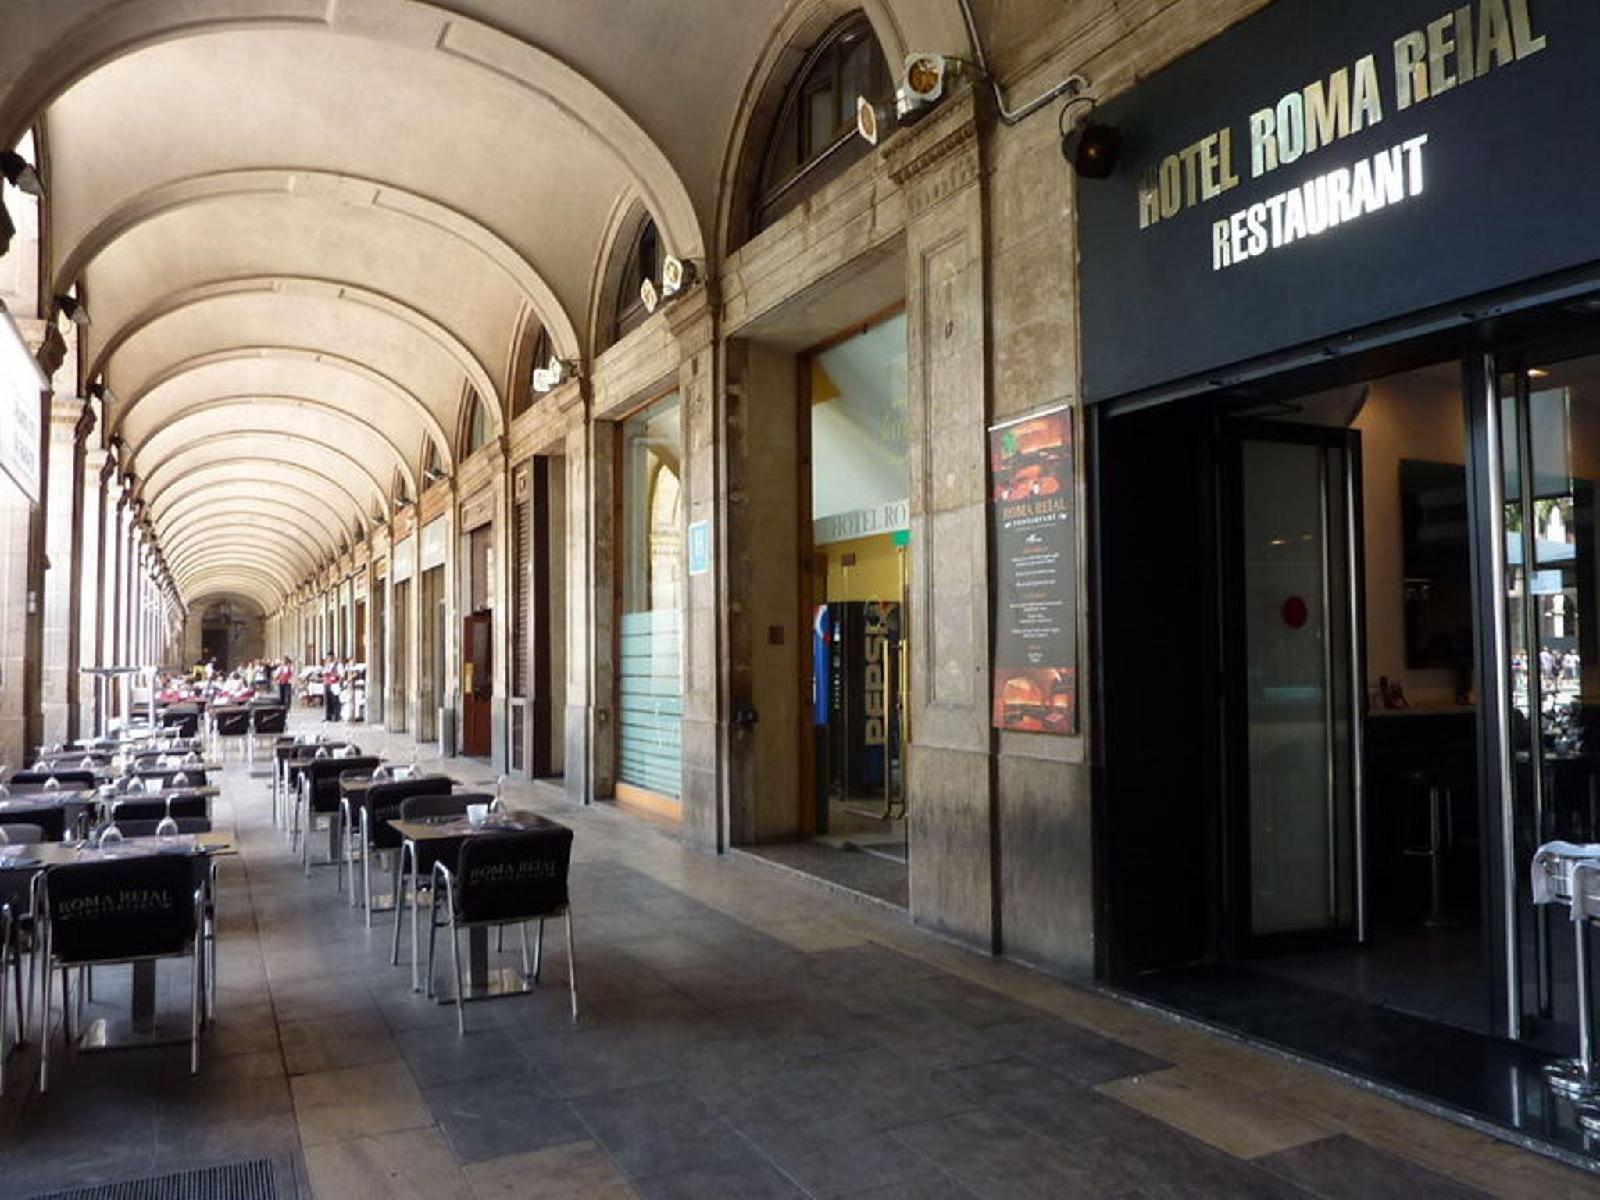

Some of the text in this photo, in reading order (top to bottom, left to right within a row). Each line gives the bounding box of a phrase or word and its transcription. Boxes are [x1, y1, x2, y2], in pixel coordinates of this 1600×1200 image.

[1138, 0, 1547, 229] HOTEL ROMA REIAL
[1212, 133, 1428, 271] RESTAURANT
